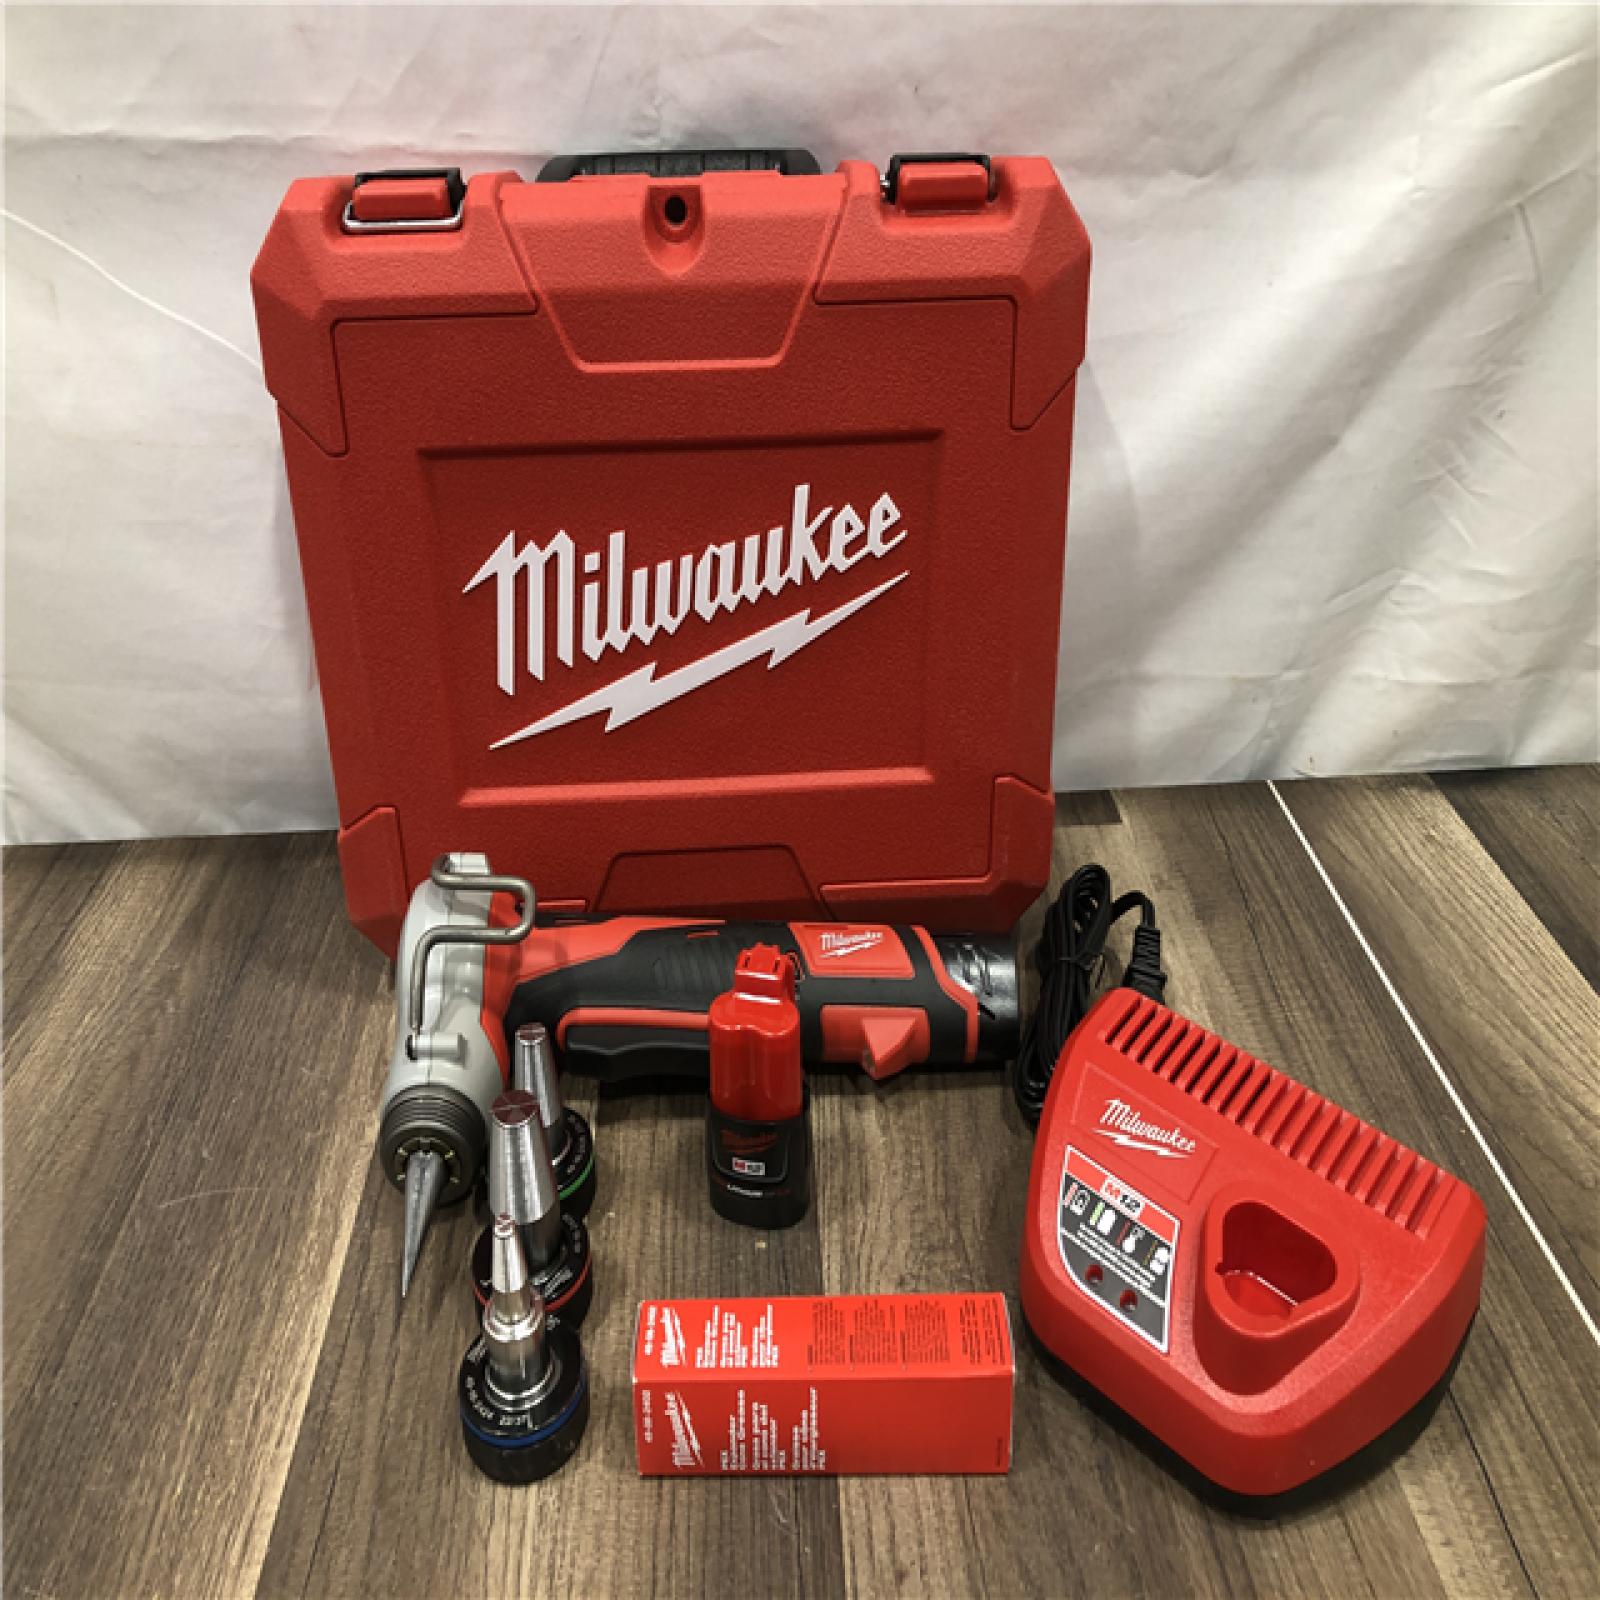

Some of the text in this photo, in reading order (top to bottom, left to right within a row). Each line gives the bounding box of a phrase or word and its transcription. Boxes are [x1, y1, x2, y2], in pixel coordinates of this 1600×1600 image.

[462, 483, 908, 696] Milwaukee
[819, 930, 884, 951] Milwaukee
[1099, 1098, 1197, 1153] Milwaukee
[1101, 1175, 1143, 1216] M12
